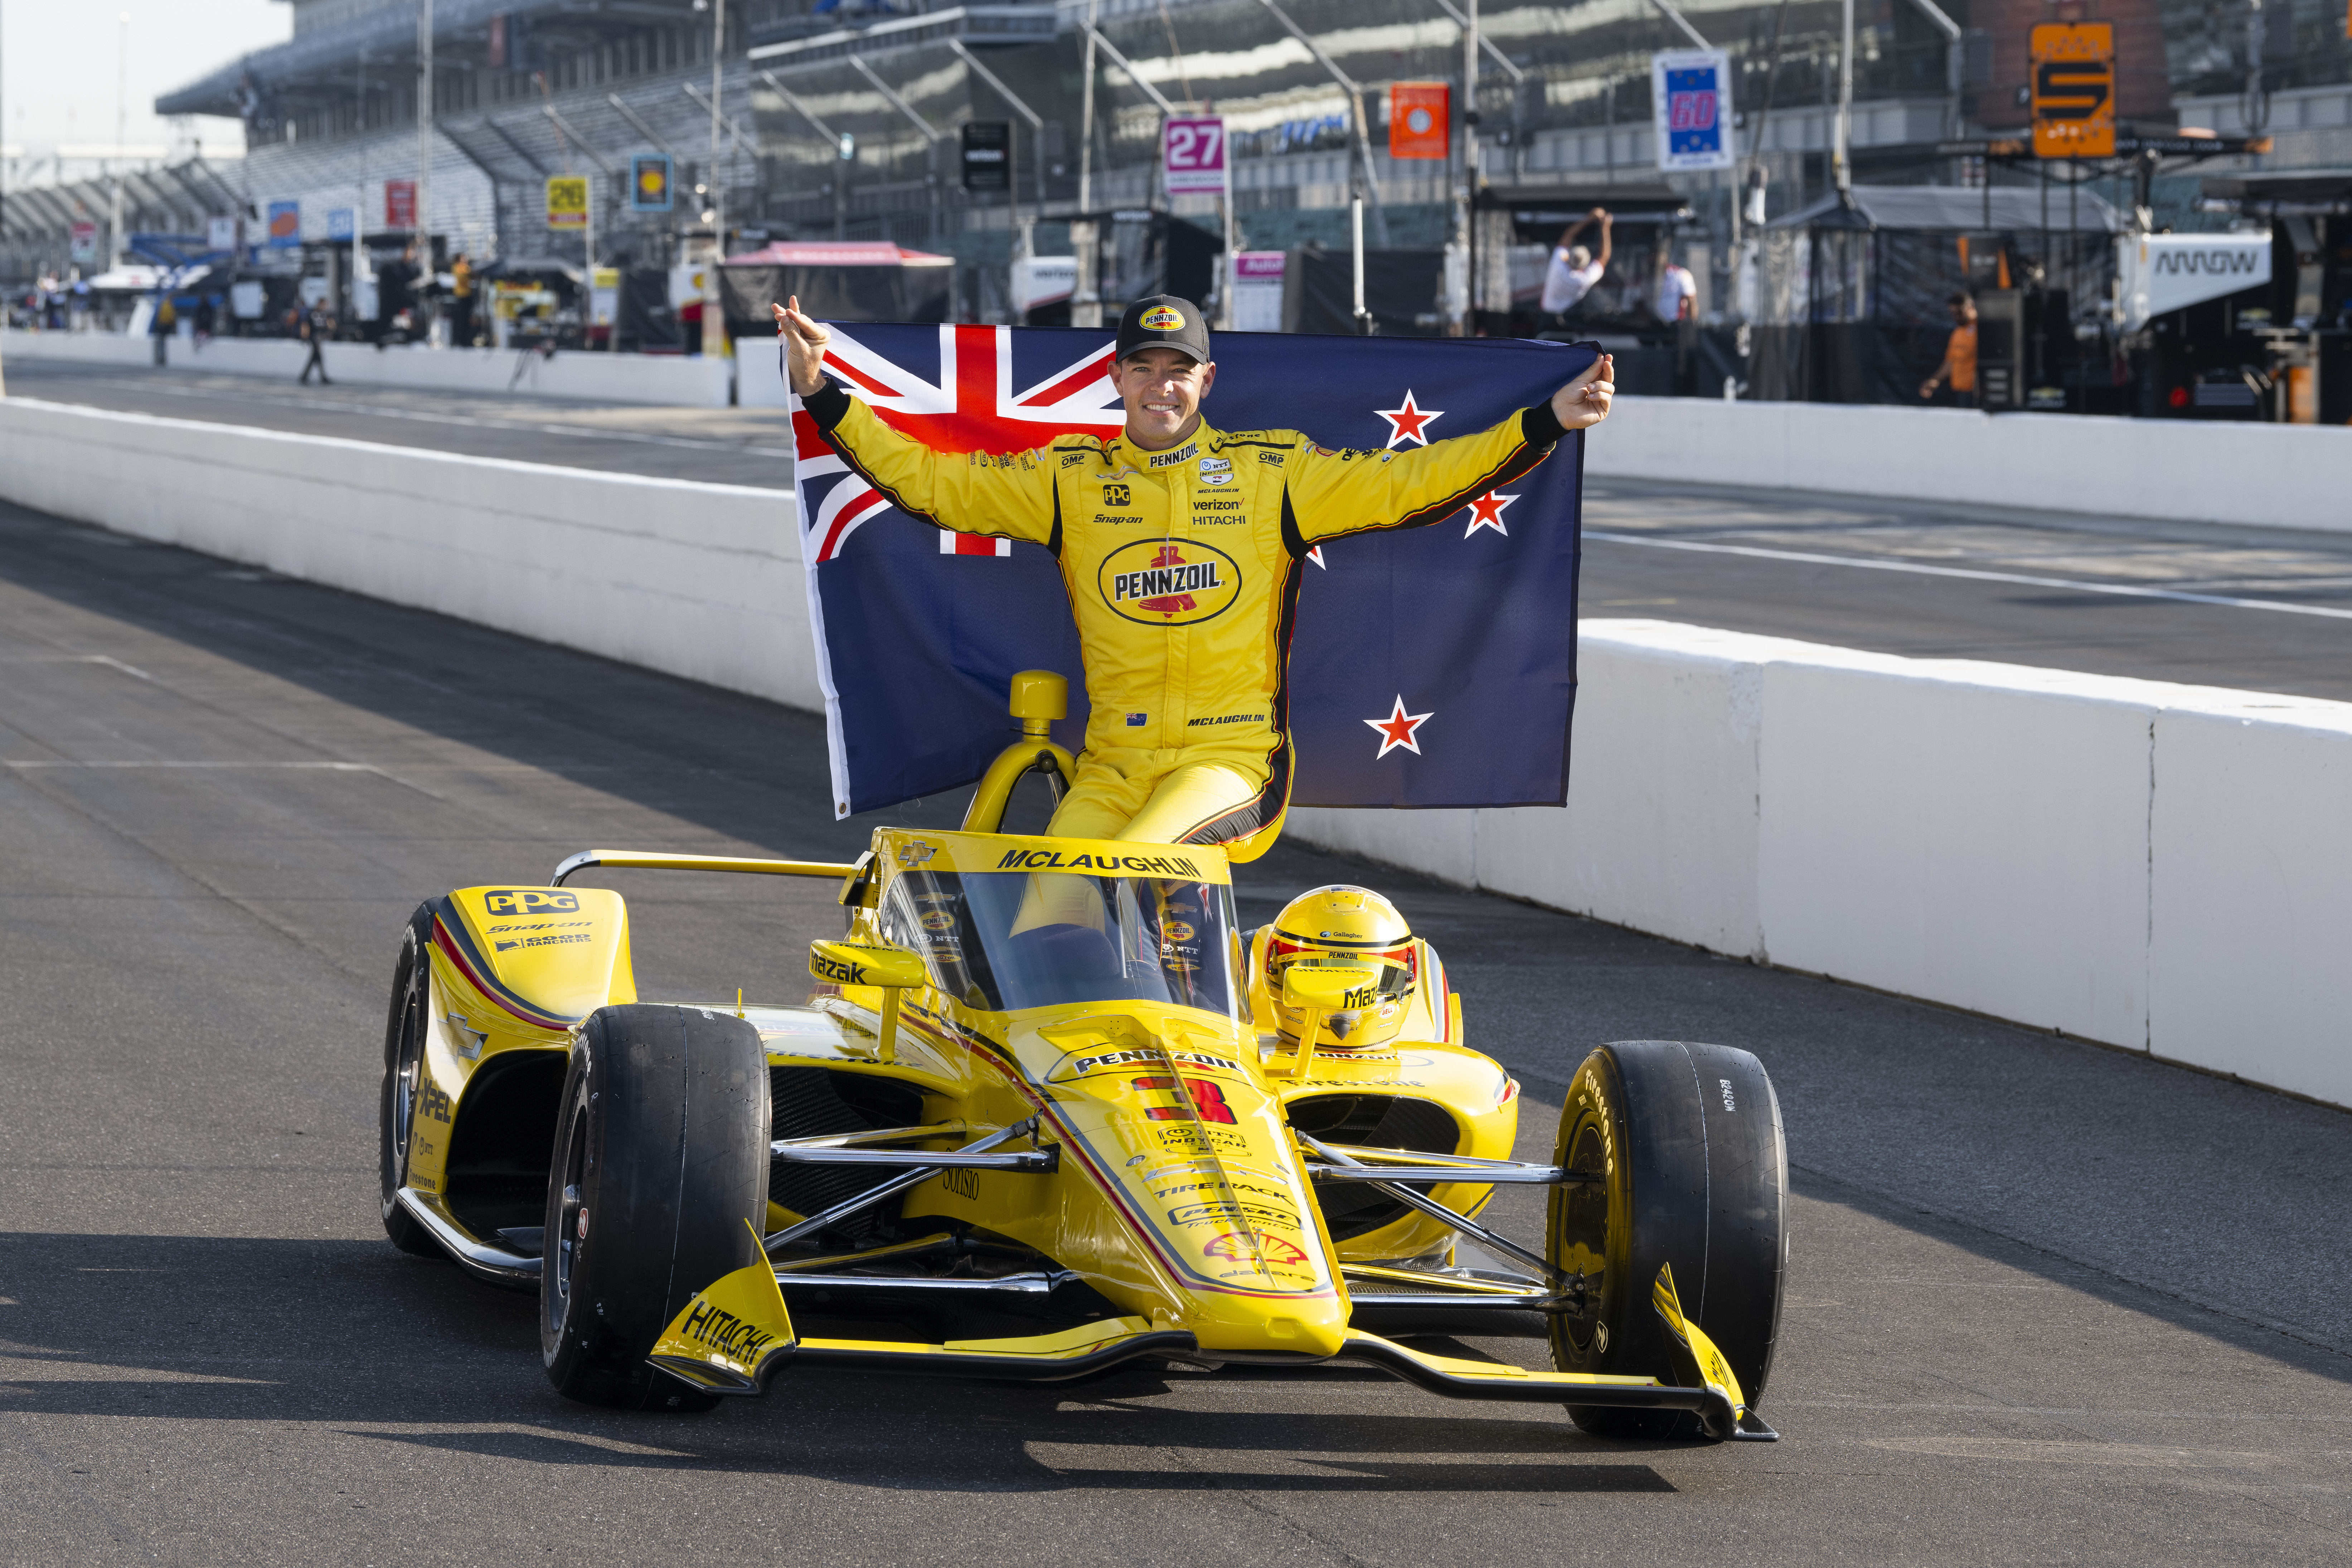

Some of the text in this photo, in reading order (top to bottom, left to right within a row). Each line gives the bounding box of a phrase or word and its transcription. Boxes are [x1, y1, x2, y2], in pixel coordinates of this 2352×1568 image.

[1669, 90, 1717, 132] 60
[1169, 126, 1221, 166] 27
[2155, 251, 2258, 276] ARROW
[1145, 314, 1178, 325] PENNZOIL
[1062, 455, 1085, 466] OMP
[1150, 441, 1199, 468] PENNZOIL
[1259, 453, 1284, 465] OMP
[1105, 486, 1129, 504] PPG
[1193, 499, 1239, 510] verizon
[1093, 514, 1143, 525] Snap-on
[1193, 515, 1246, 525] HITACHI
[1114, 561, 1222, 602] PENNZOIL
[1187, 714, 1265, 727] MCLAUGHLIN
[996, 849, 1203, 878] MCLAUGHLIN
[488, 892, 576, 913] PPG
[485, 922, 593, 934] Snap-on
[922, 917, 951, 926] PENNZOIL
[527, 938, 592, 947] RANCHERS
[829, 943, 903, 952] SIEMENS
[1176, 946, 1198, 955] NTT
[1328, 952, 1358, 960] PENNZOIL
[811, 947, 868, 985] Mazak
[1073, 1049, 1246, 1074] PENNZOIL
[418, 1077, 451, 1124] XPEL
[1130, 1076, 1238, 1125] 3
[1586, 1069, 1613, 1175] Firestone
[424, 1142, 433, 1155] NTT
[1163, 1137, 1247, 1149] INDYCAR
[409, 1167, 436, 1190] Firestone
[1154, 1181, 1298, 1208] TIRE RACK
[1182, 1205, 1294, 1220] PENSKE
[1187, 1218, 1295, 1231] Truck Rental
[1219, 1268, 1317, 1283] dallara
[681, 1300, 775, 1365] HITACHI
